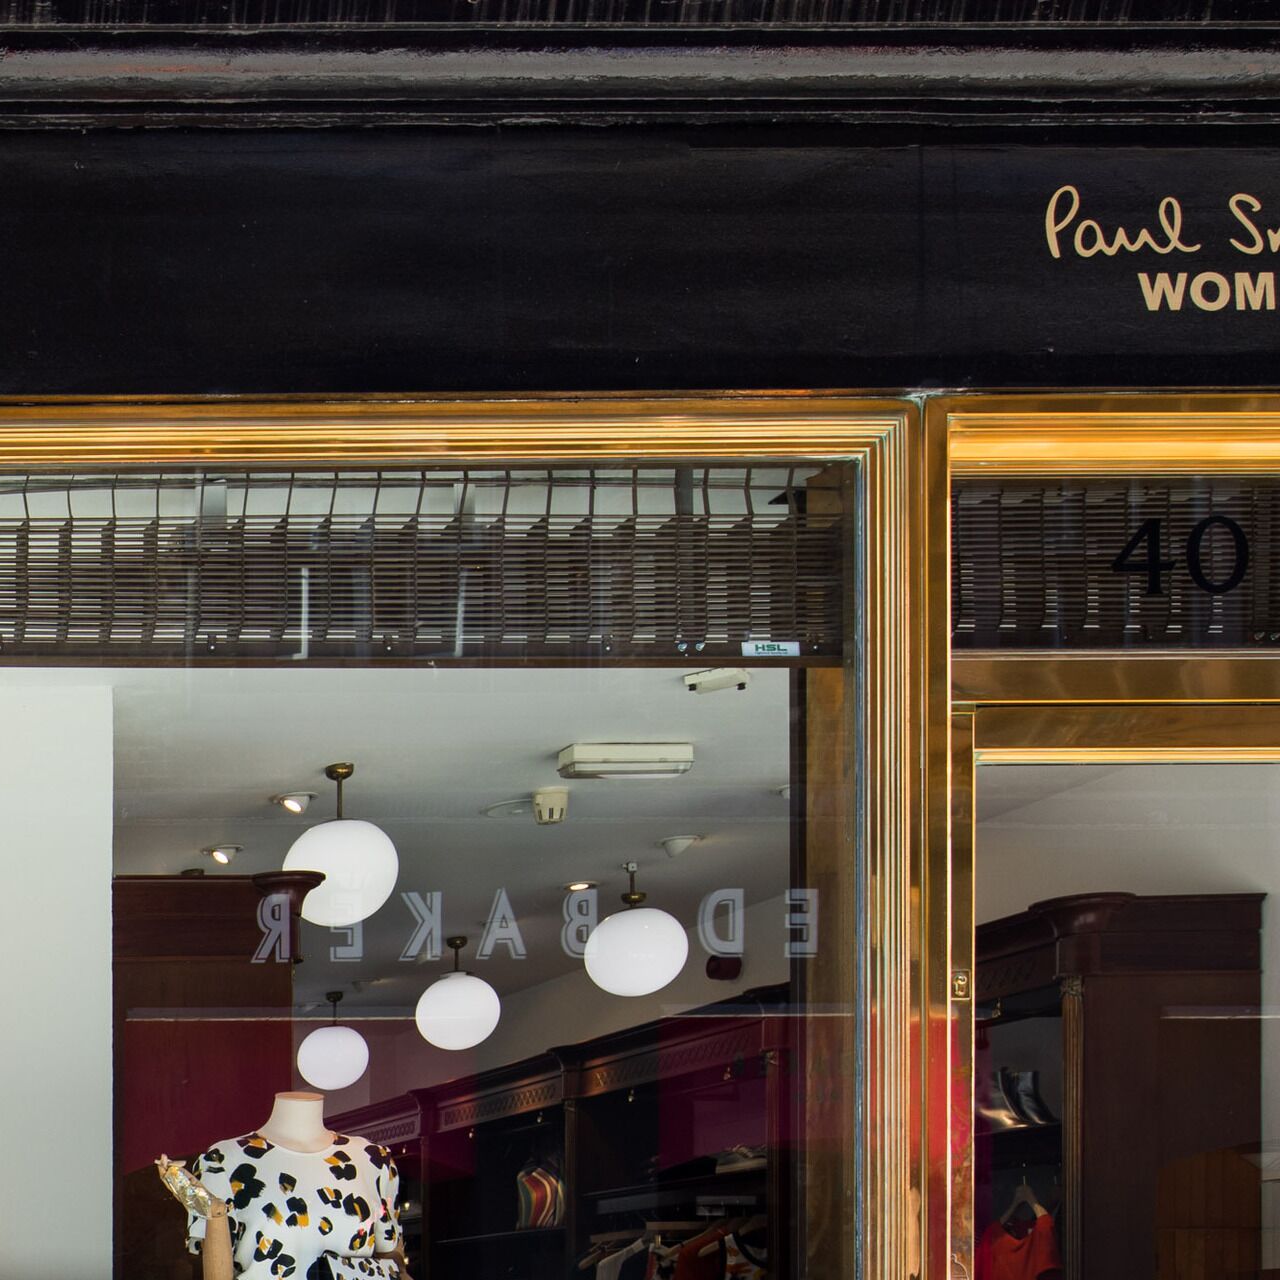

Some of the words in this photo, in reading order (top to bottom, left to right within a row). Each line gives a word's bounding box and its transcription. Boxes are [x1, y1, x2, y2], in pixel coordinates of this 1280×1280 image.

[1046, 185, 1201, 259] Paul
[1111, 514, 1251, 596] 40
[754, 644, 788, 652] HSL
